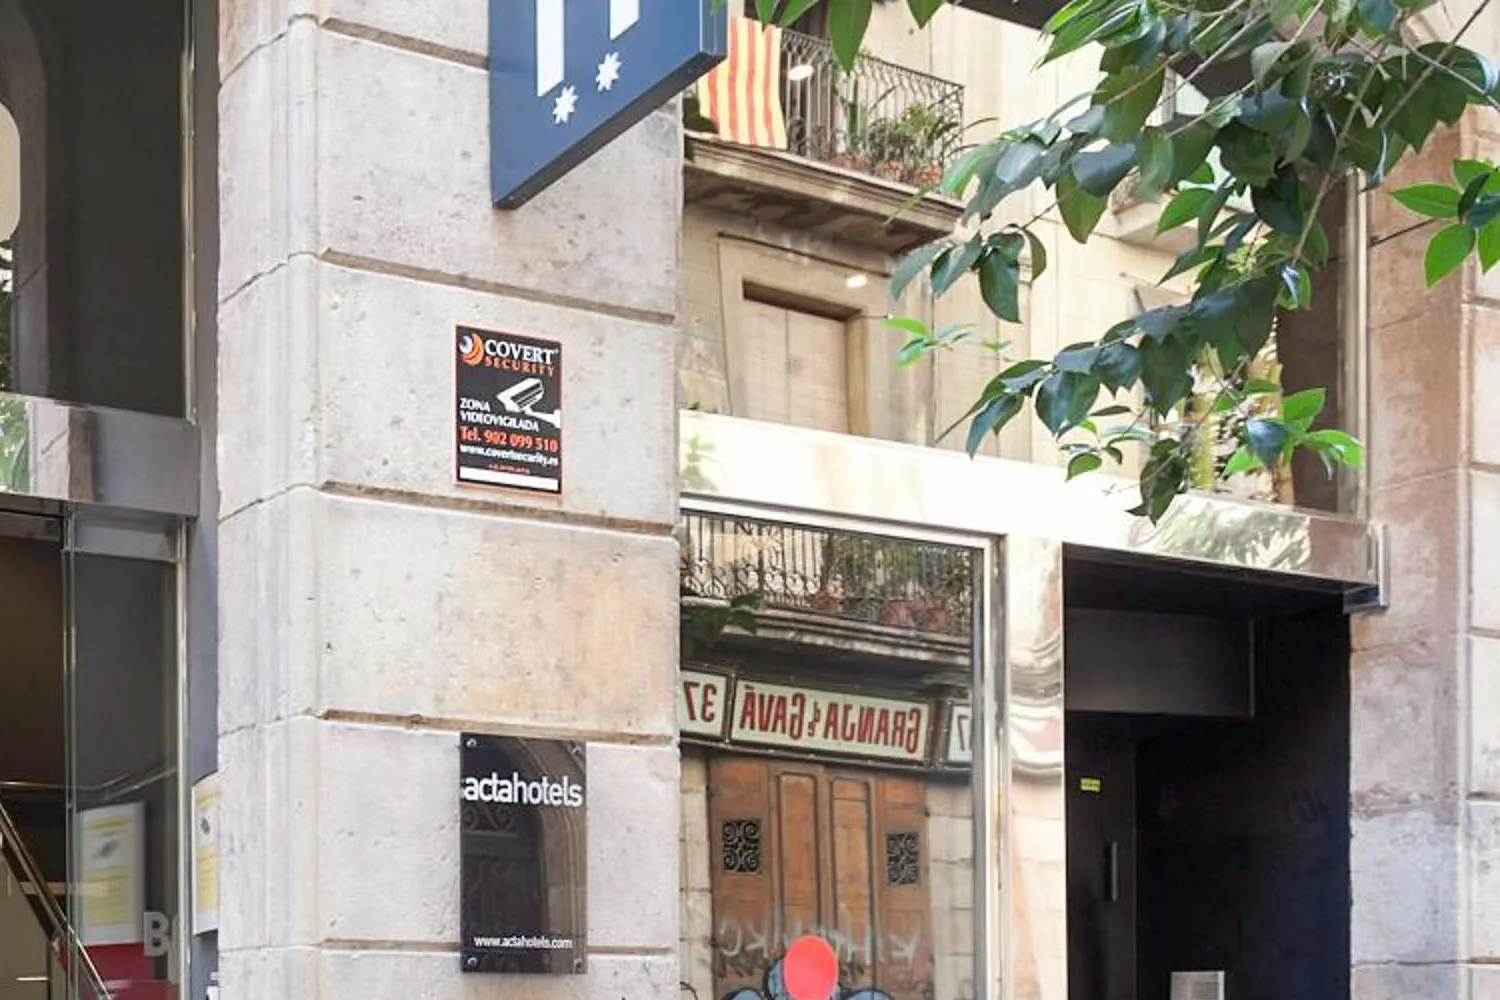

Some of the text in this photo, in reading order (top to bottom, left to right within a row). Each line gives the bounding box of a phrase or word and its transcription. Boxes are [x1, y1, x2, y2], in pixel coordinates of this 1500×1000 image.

[485, 339, 555, 364] COVERT
[484, 356, 555, 377] SECURITY
[460, 397, 491, 412] ZONA
[460, 411, 539, 432] VIDEOVIGILADA
[460, 426, 481, 442] Tel.
[464, 772, 583, 807] actahotels
[473, 935, 573, 949] www.actahotels.com
